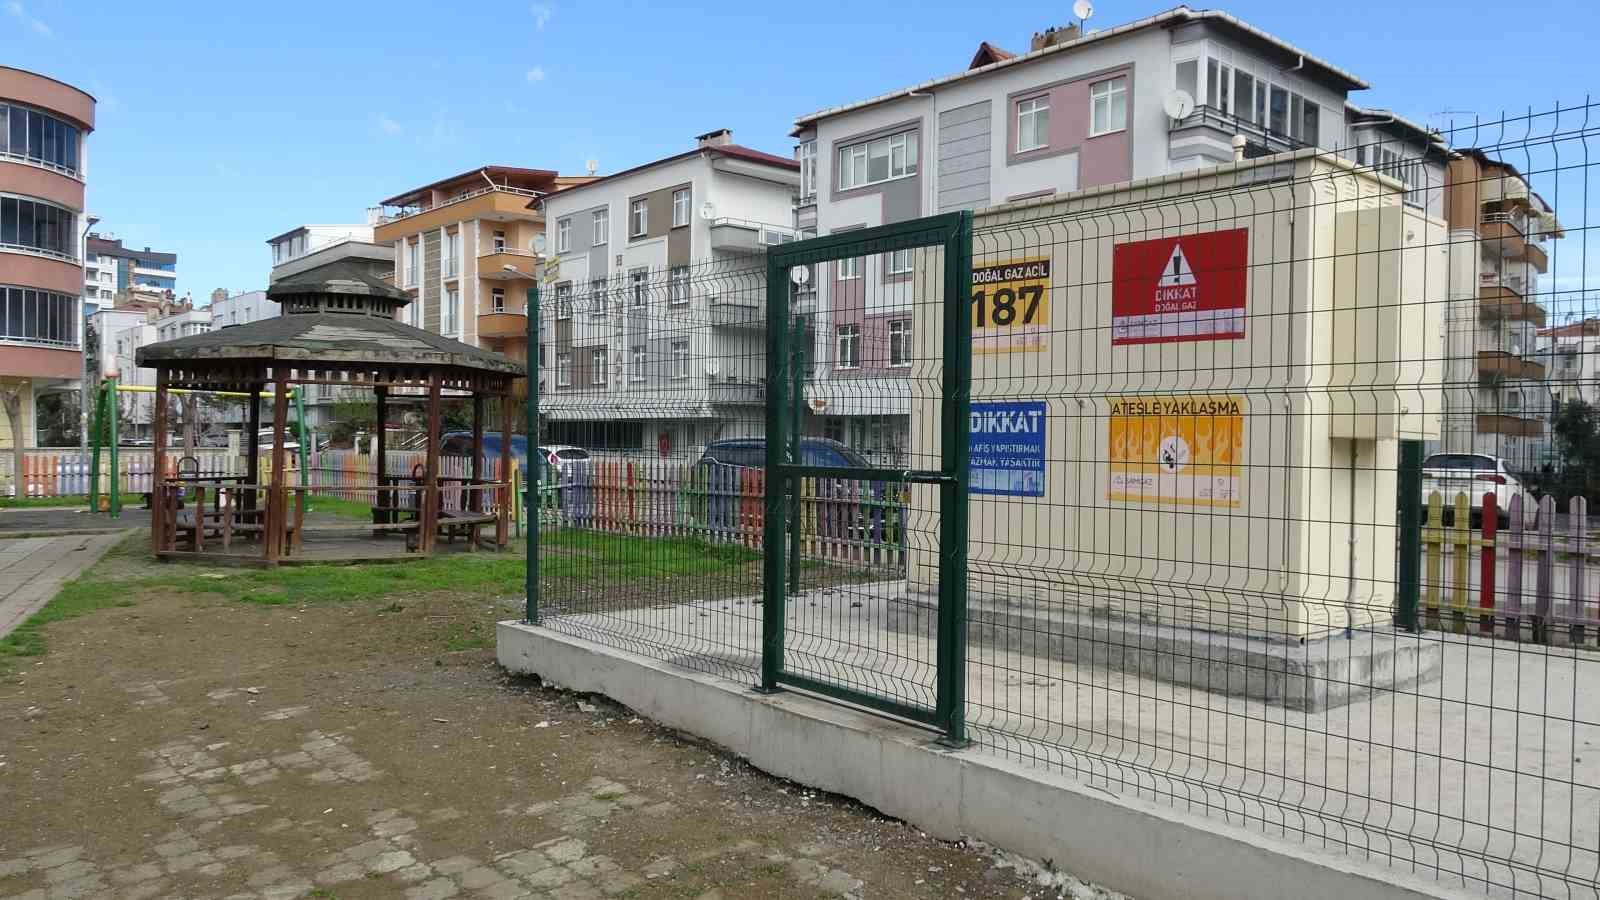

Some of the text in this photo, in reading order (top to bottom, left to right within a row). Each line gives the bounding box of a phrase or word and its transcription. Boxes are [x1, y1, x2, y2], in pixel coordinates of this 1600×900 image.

[972, 269, 1003, 283] DOĞAL
[1004, 267, 1024, 280] GAZ
[971, 285, 1044, 327] 187
[1181, 301, 1197, 311] GAZ
